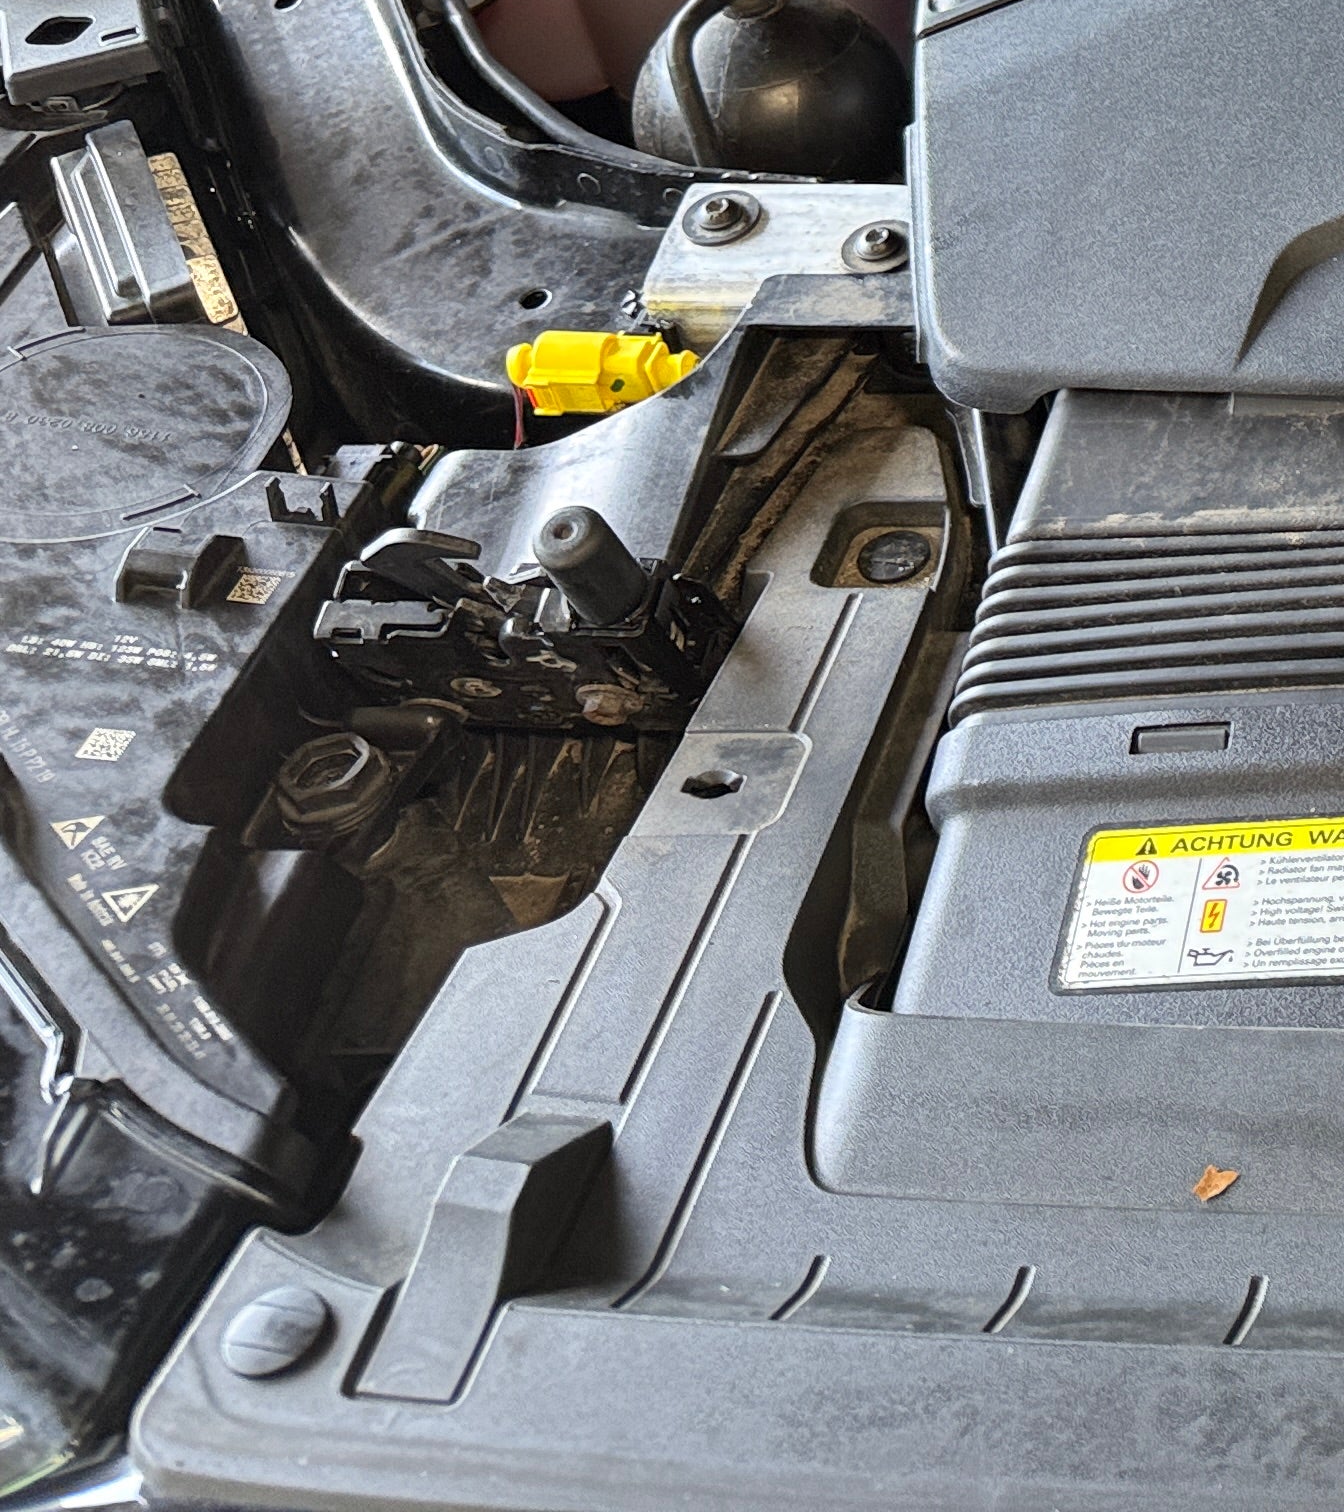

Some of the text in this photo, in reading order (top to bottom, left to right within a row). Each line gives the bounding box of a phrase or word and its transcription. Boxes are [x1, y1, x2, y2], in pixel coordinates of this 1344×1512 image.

[1170, 831, 1293, 853] ACHTUNG
[1309, 864, 1324, 872] fan
[1259, 907, 1282, 917] High
[1108, 919, 1140, 928] engine
[1302, 946, 1336, 956] engine
